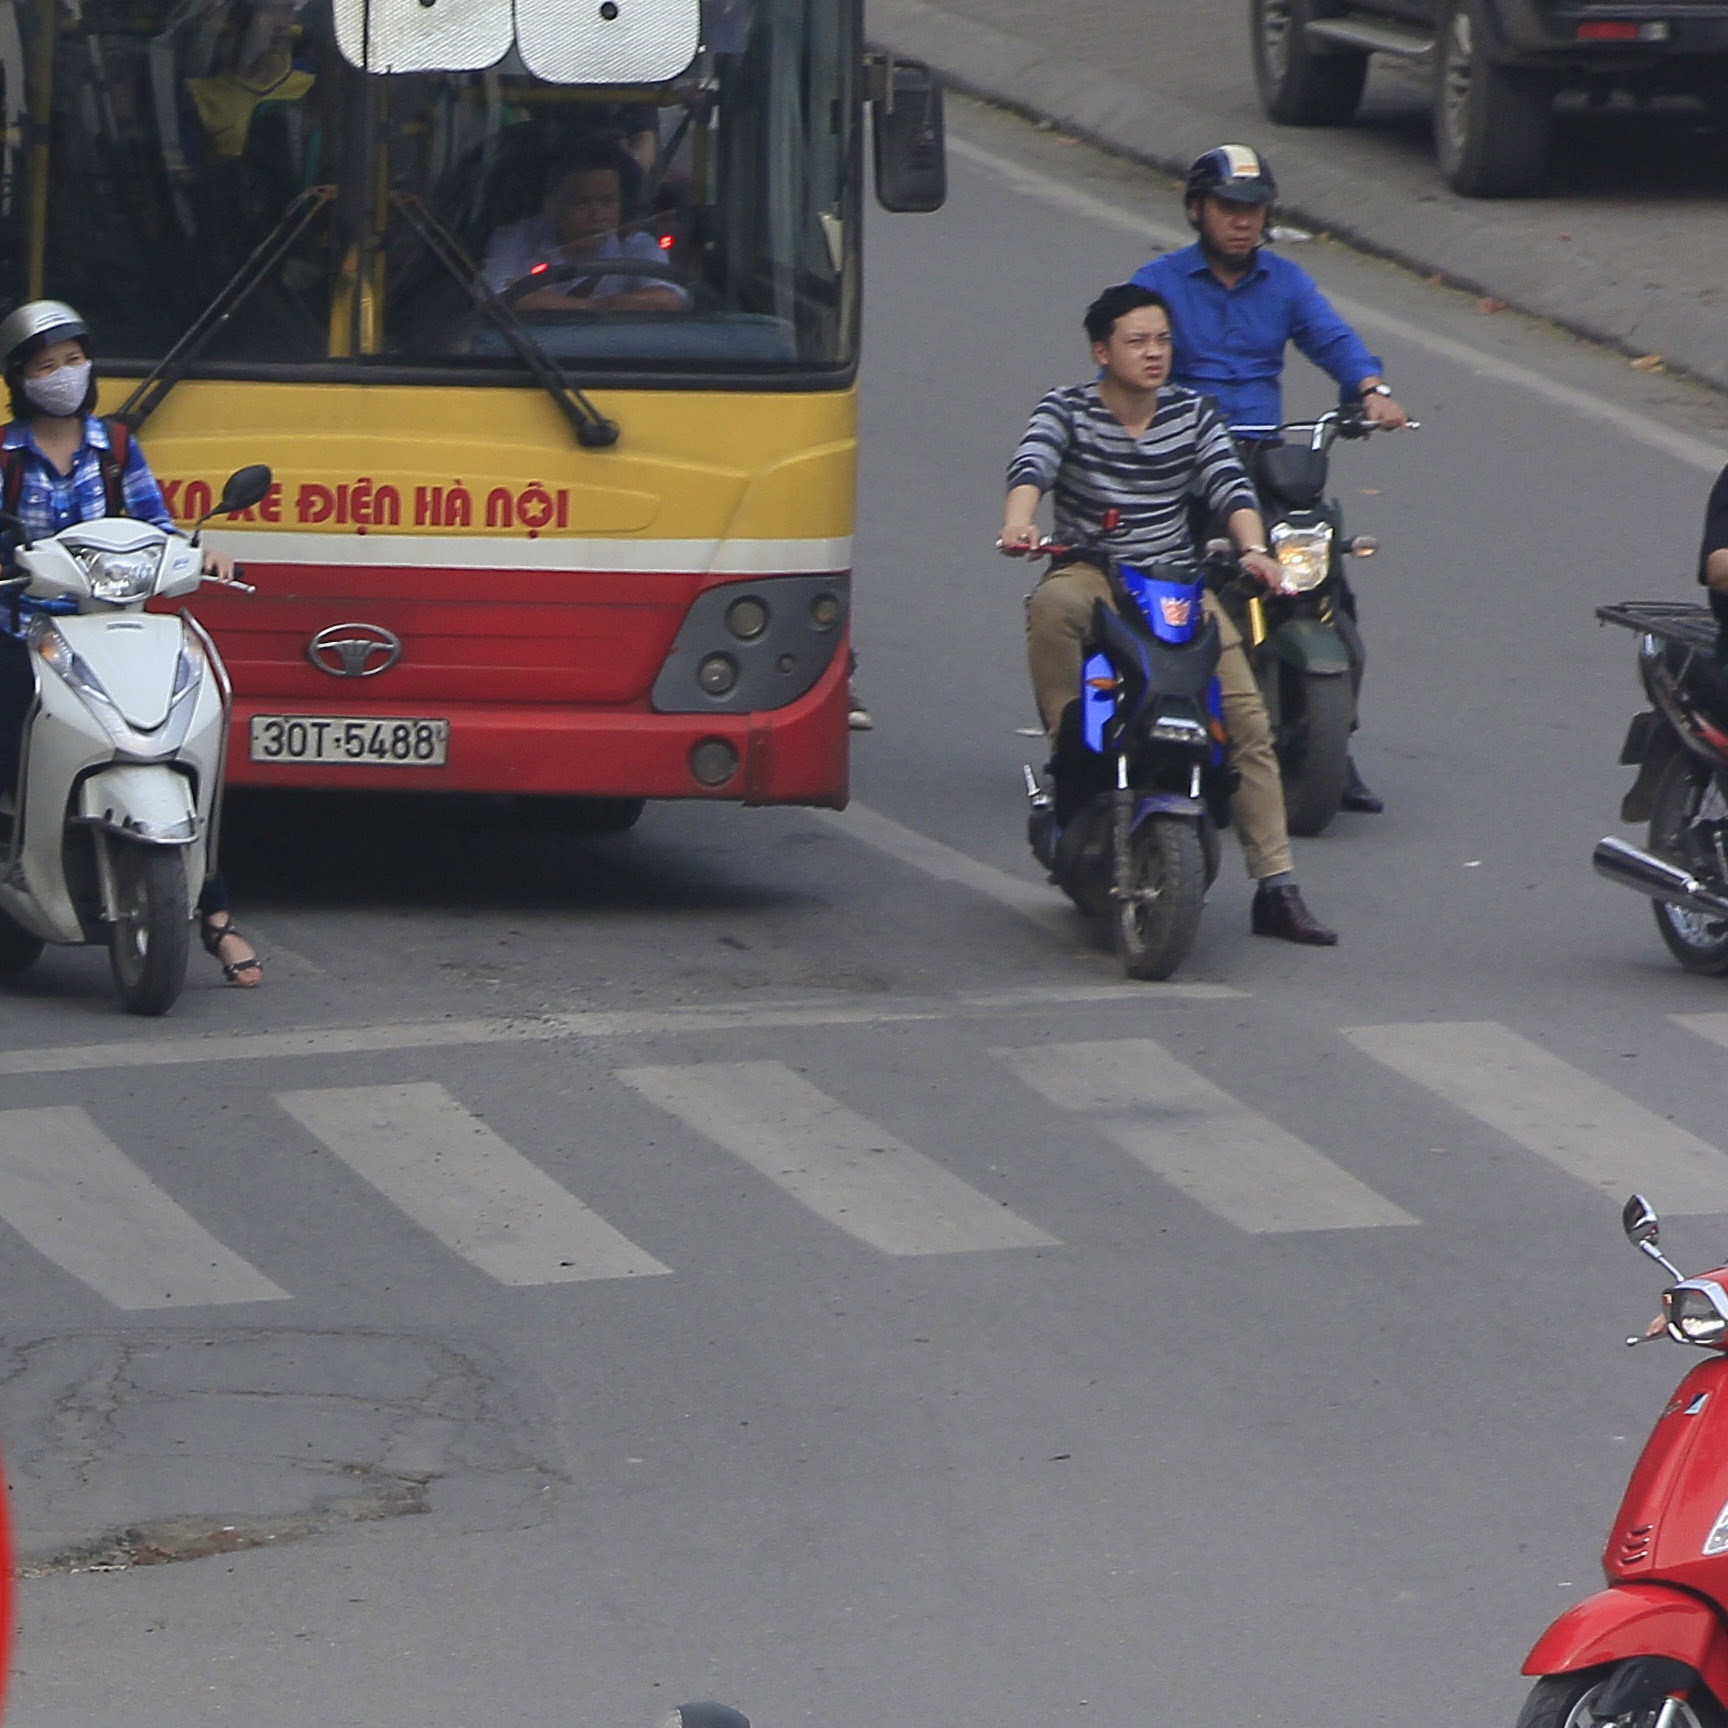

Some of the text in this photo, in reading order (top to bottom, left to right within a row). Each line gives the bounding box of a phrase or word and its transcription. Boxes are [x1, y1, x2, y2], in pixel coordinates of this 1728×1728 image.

[296, 477, 401, 537] ĐIỆN
[414, 478, 472, 528] HÀ
[485, 481, 571, 540] NỘI
